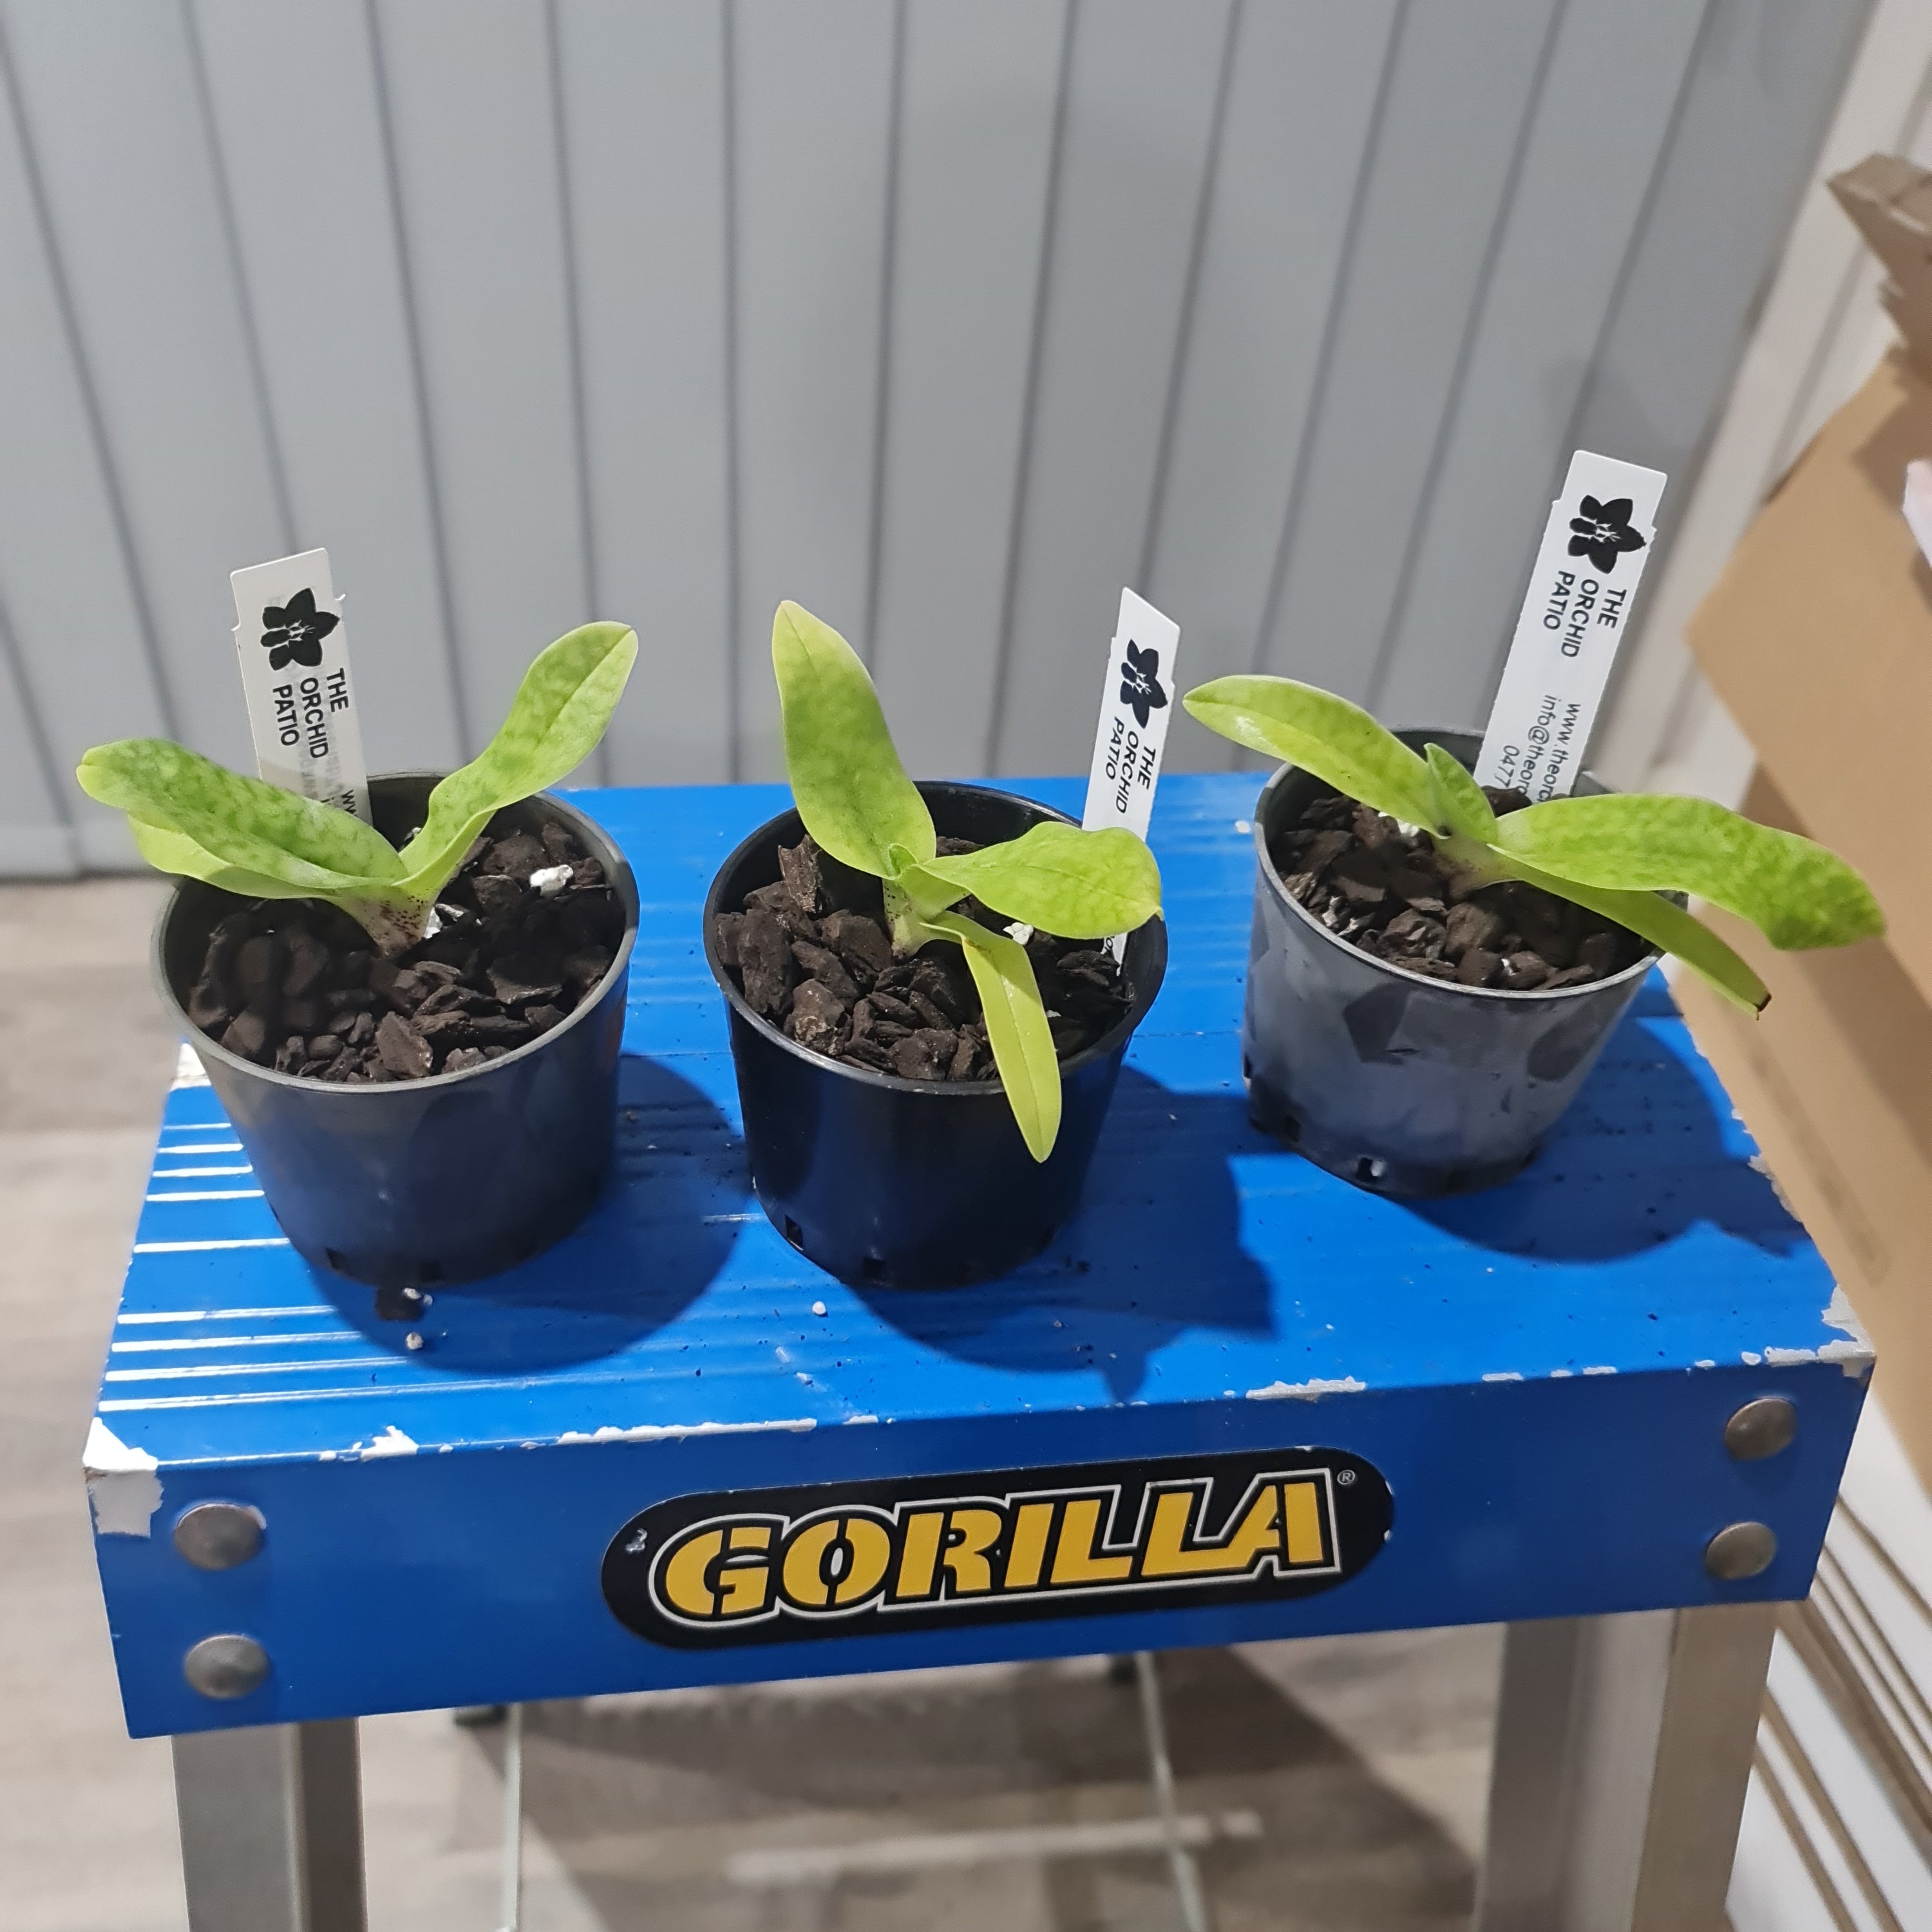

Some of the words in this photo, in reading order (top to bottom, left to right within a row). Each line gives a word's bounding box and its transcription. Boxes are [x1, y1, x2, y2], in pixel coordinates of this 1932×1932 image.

[1543, 570, 1575, 630] PATIO
[1560, 579, 1599, 658] ORCHID
[1597, 589, 1627, 629] THE
[272, 684, 300, 746] PATIO
[299, 677, 329, 759] ORCHID
[326, 667, 349, 713] THE
[1105, 715, 1125, 781] PATIO
[1115, 730, 1139, 814] ORCHID
[1137, 746, 1157, 790] THE
[1494, 744, 1520, 788] 0477
[1537, 703, 1582, 802] www.theorc
[656, 1475, 1333, 1622] GORILLA
